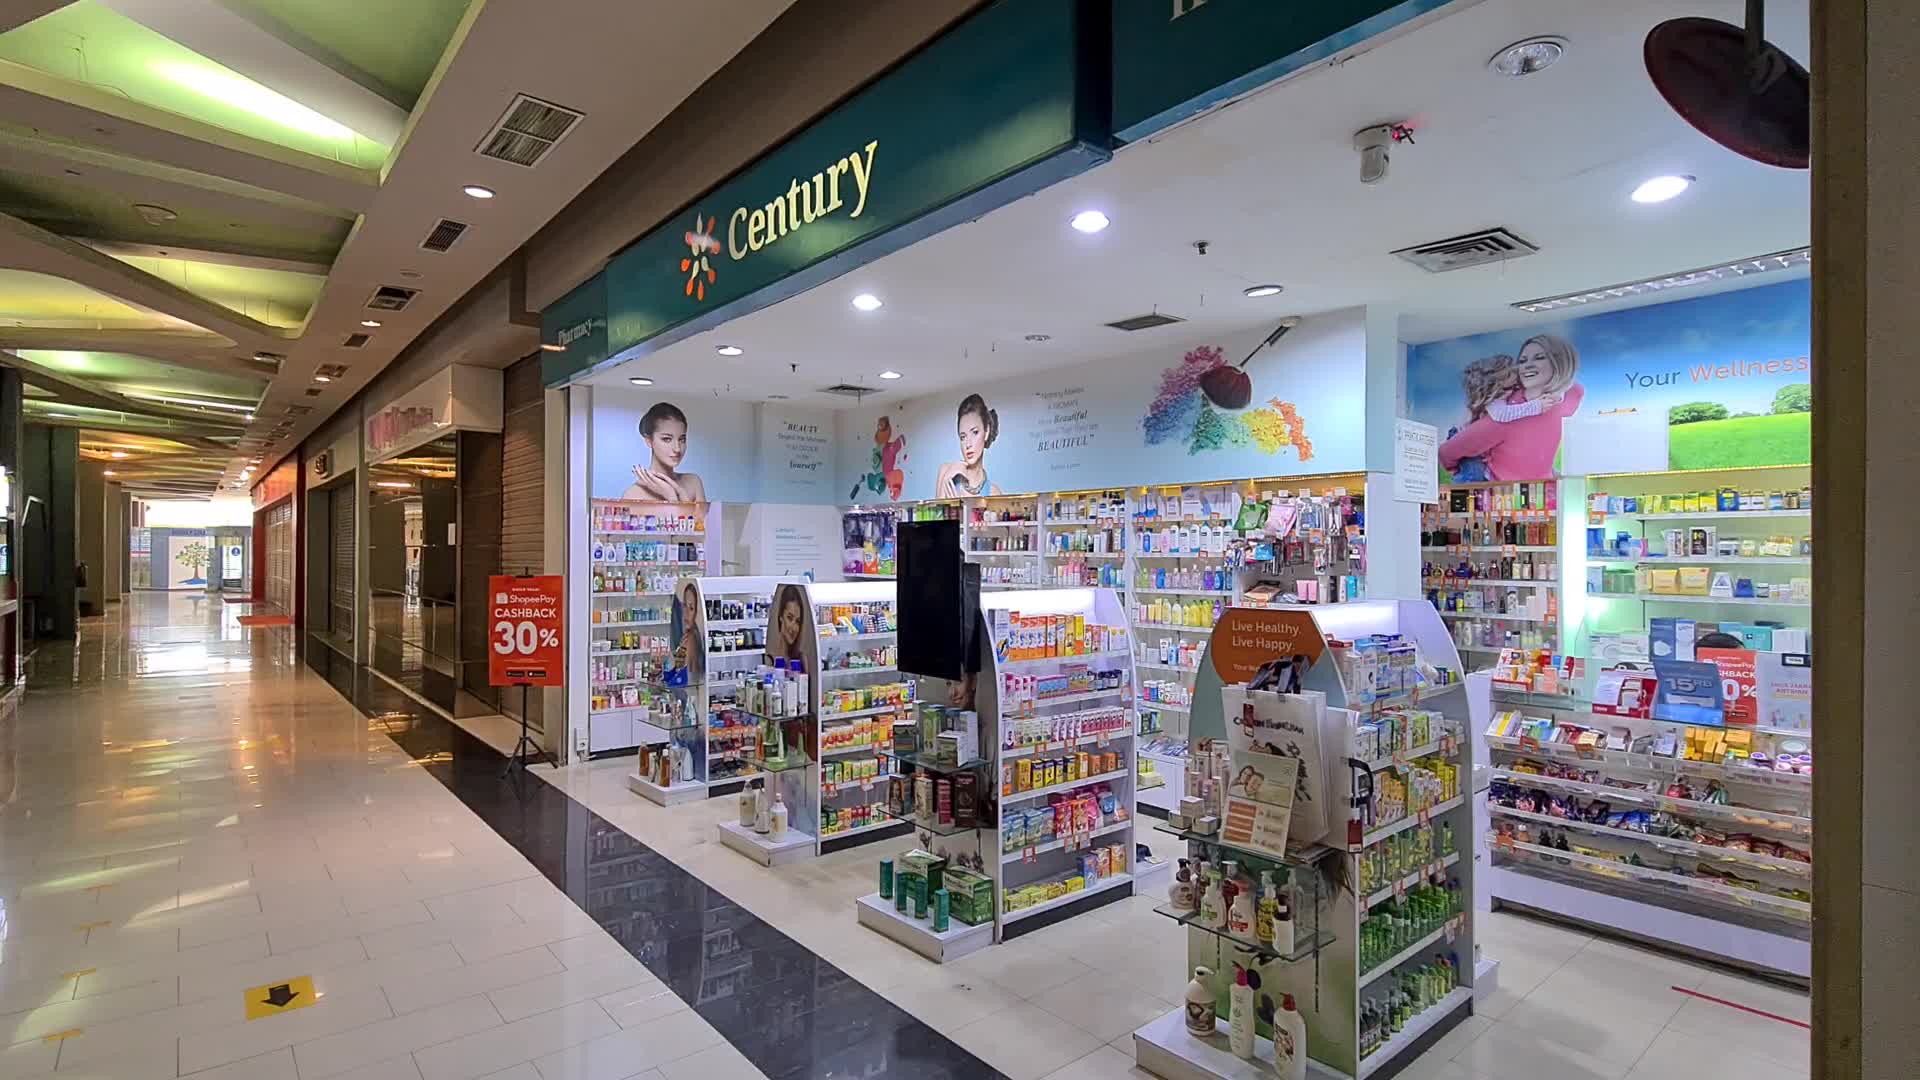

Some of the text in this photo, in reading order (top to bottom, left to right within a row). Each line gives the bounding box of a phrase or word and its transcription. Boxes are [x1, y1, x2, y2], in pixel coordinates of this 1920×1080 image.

[728, 140, 878, 260] Century
[1625, 357, 1809, 388] Your Wellness
[509, 594, 557, 605] ShopeePay
[495, 608, 556, 618] CASHBACK
[1232, 620, 1302, 637] Live Healthy.
[494, 621, 559, 655] 30%
[1232, 636, 1296, 653] Live Happy.
